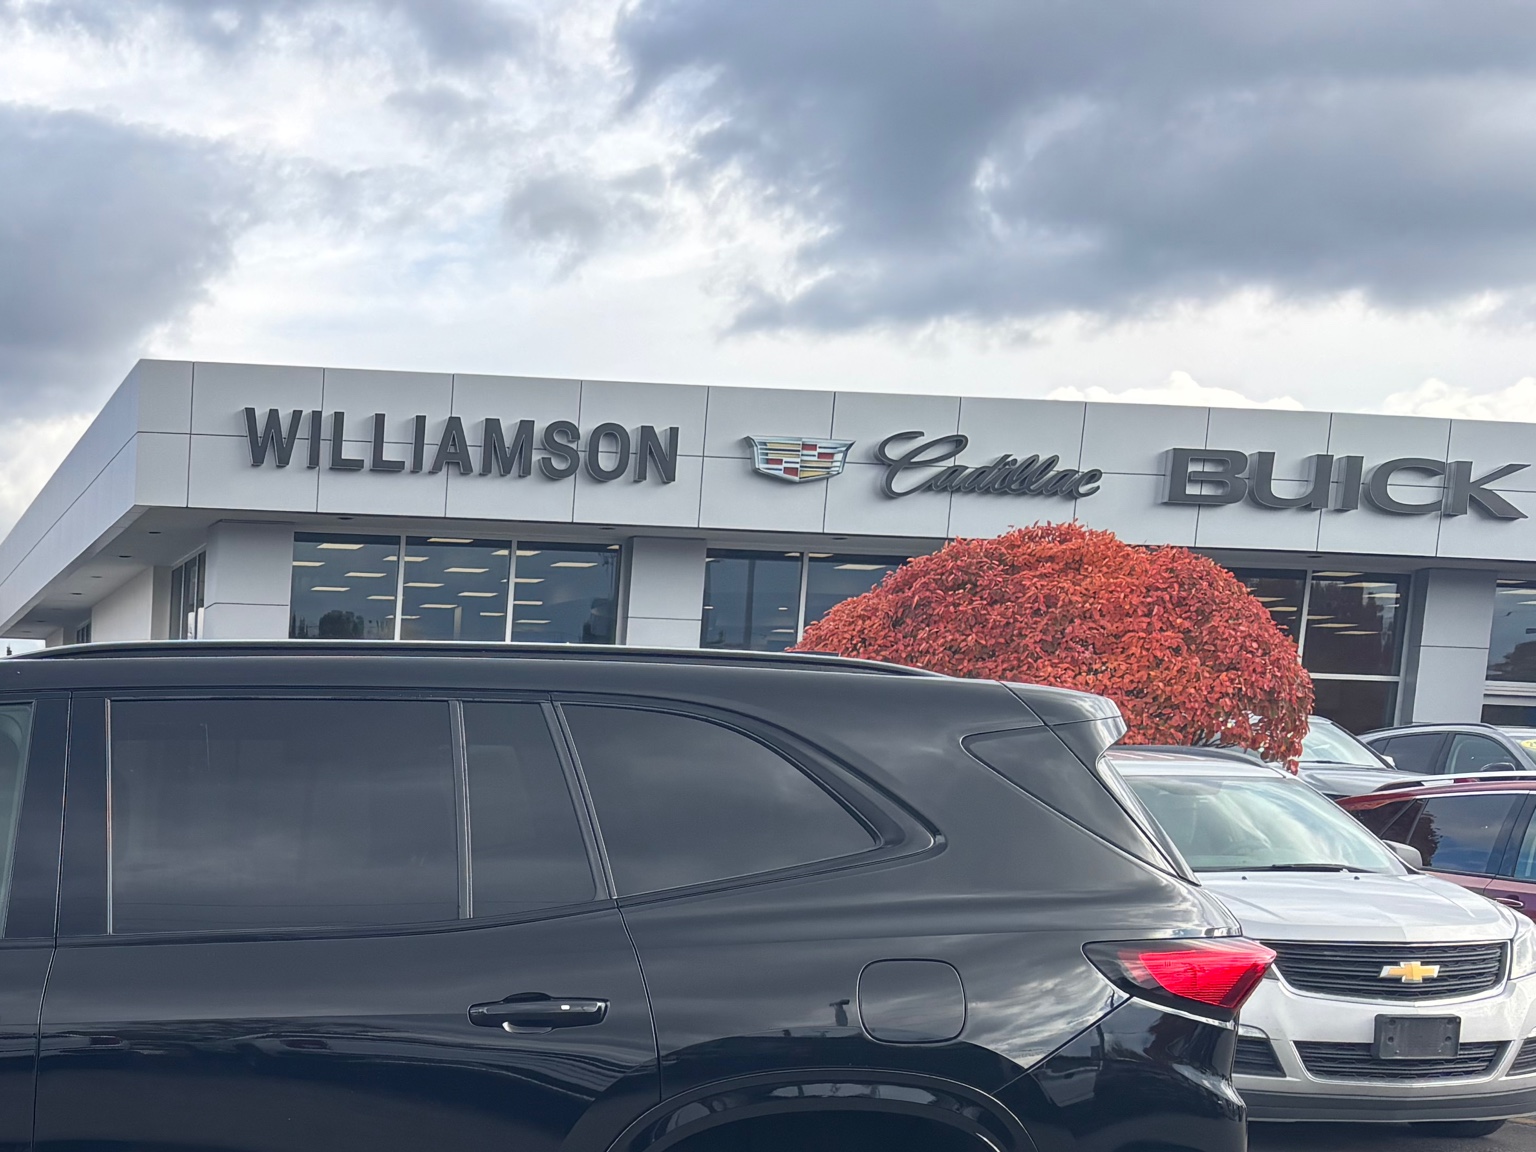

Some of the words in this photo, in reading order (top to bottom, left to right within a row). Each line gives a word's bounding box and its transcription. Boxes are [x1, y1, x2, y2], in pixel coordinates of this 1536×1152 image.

[244, 407, 679, 483] WILLIAMSON
[874, 431, 1102, 498] Cadillac
[1164, 447, 1531, 519] BUICK
